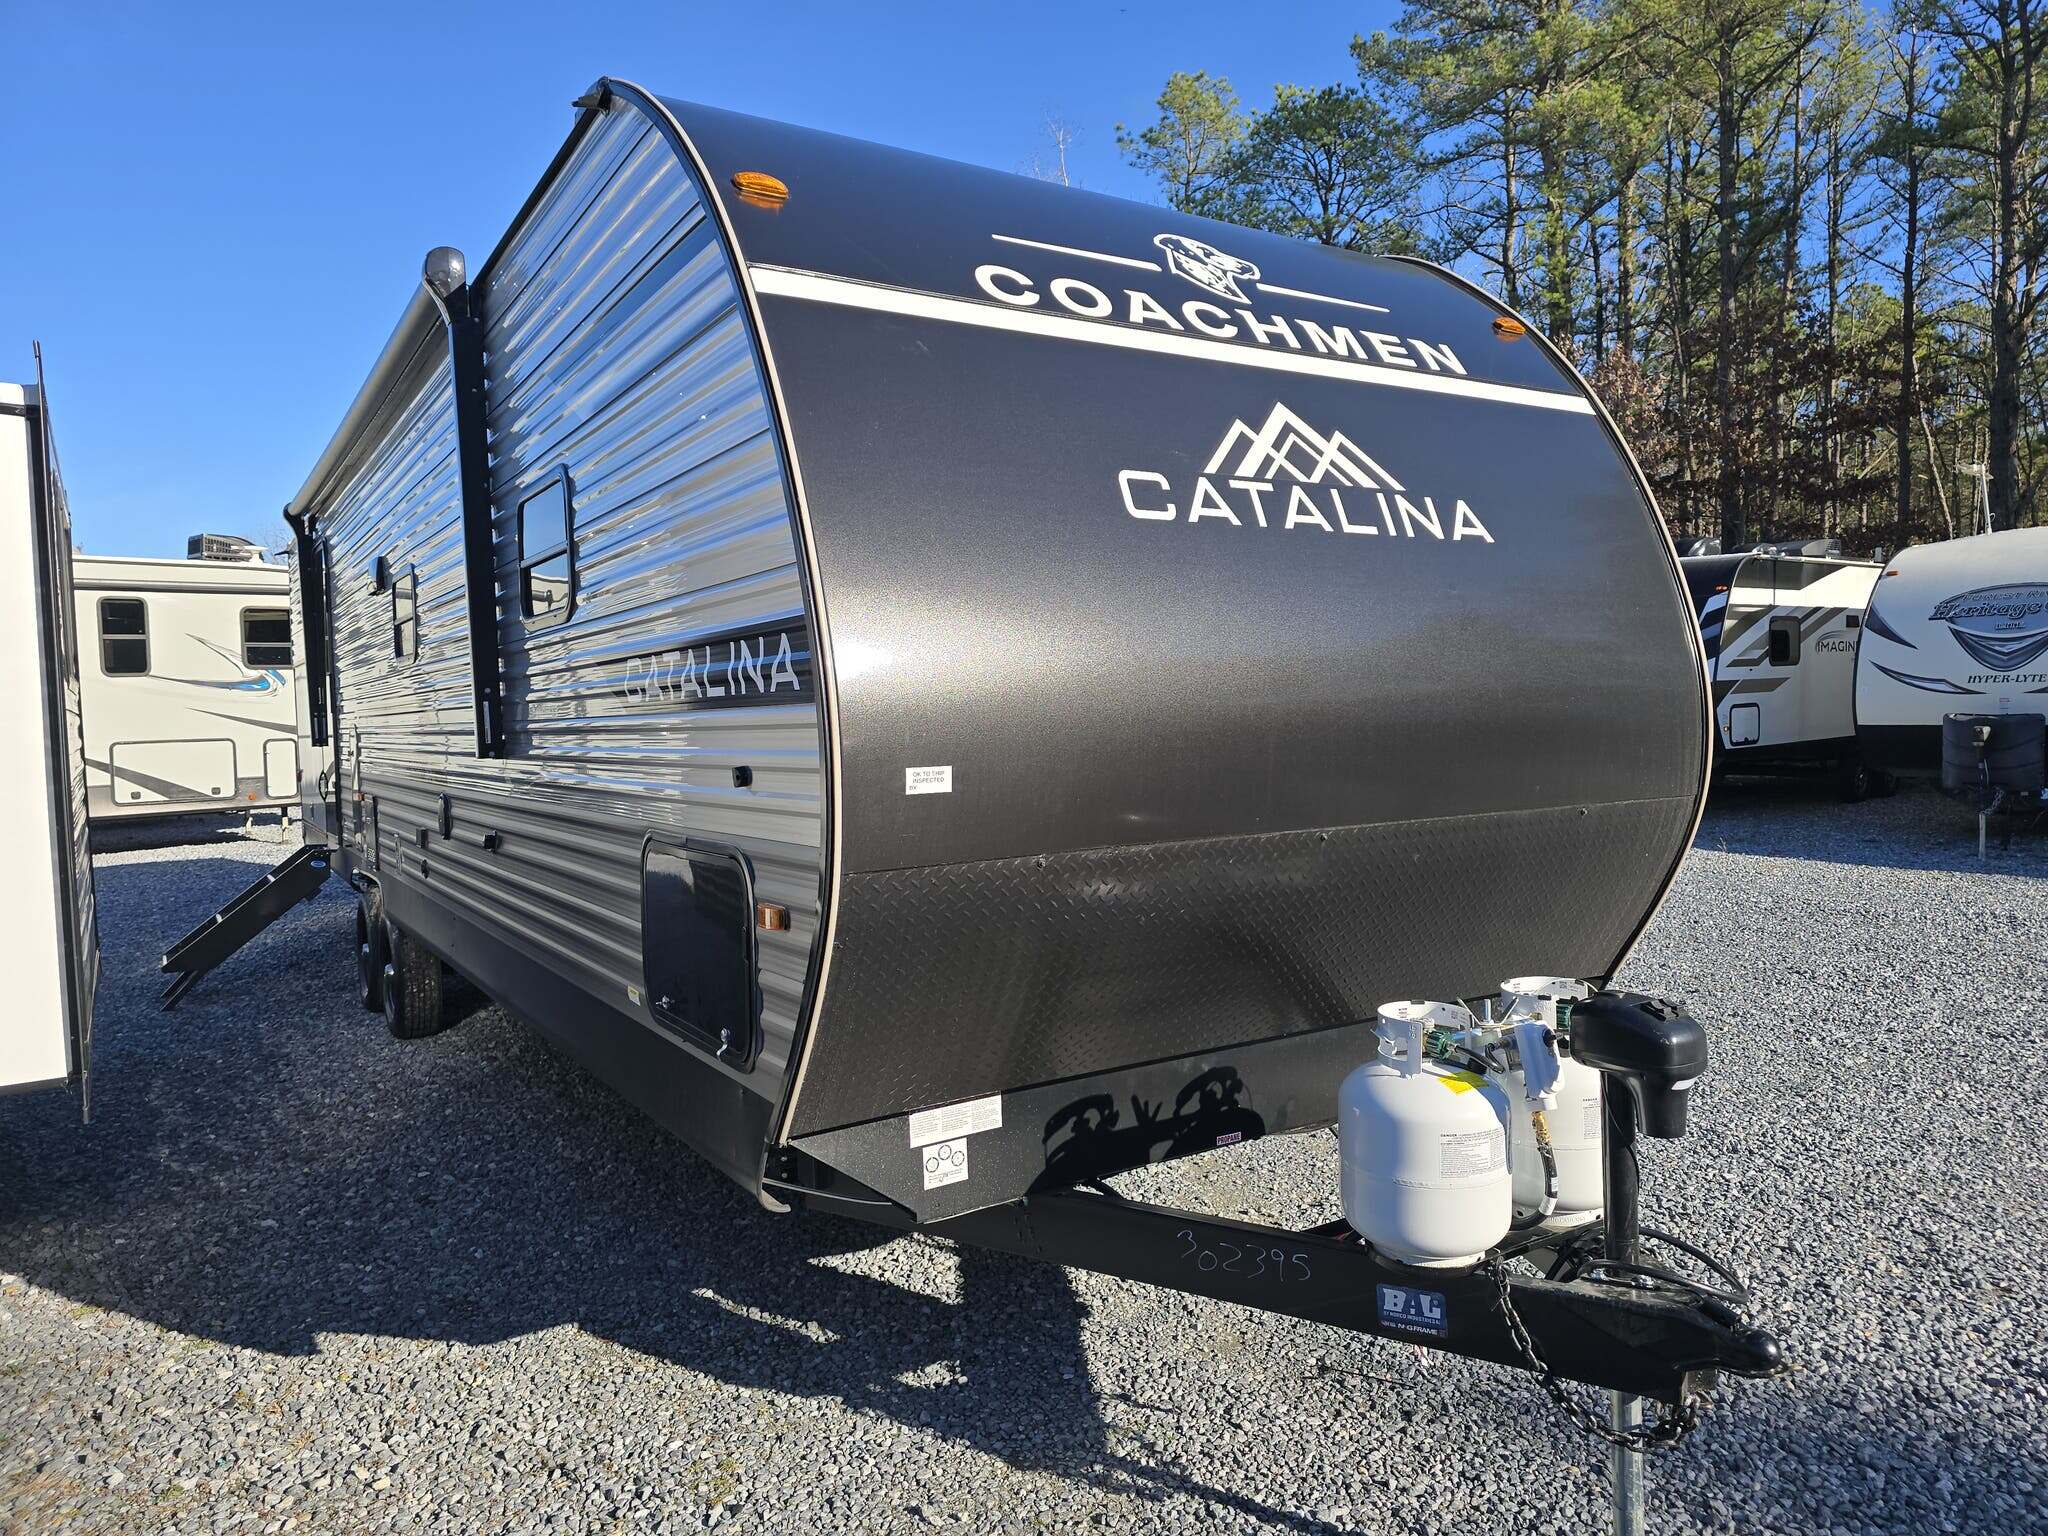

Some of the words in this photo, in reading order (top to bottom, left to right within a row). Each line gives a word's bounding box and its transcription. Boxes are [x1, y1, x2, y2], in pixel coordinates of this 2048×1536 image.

[974, 263, 1468, 375] COACHMEN
[1117, 469, 1495, 543] CATALINA
[624, 633, 800, 703] CATALINA
[1817, 640, 1857, 652] IMAGIN
[1967, 674, 2047, 683] HYPER-LYTE
[1177, 1229, 1311, 1282] 302395
[1383, 1288, 1440, 1319] BAL
